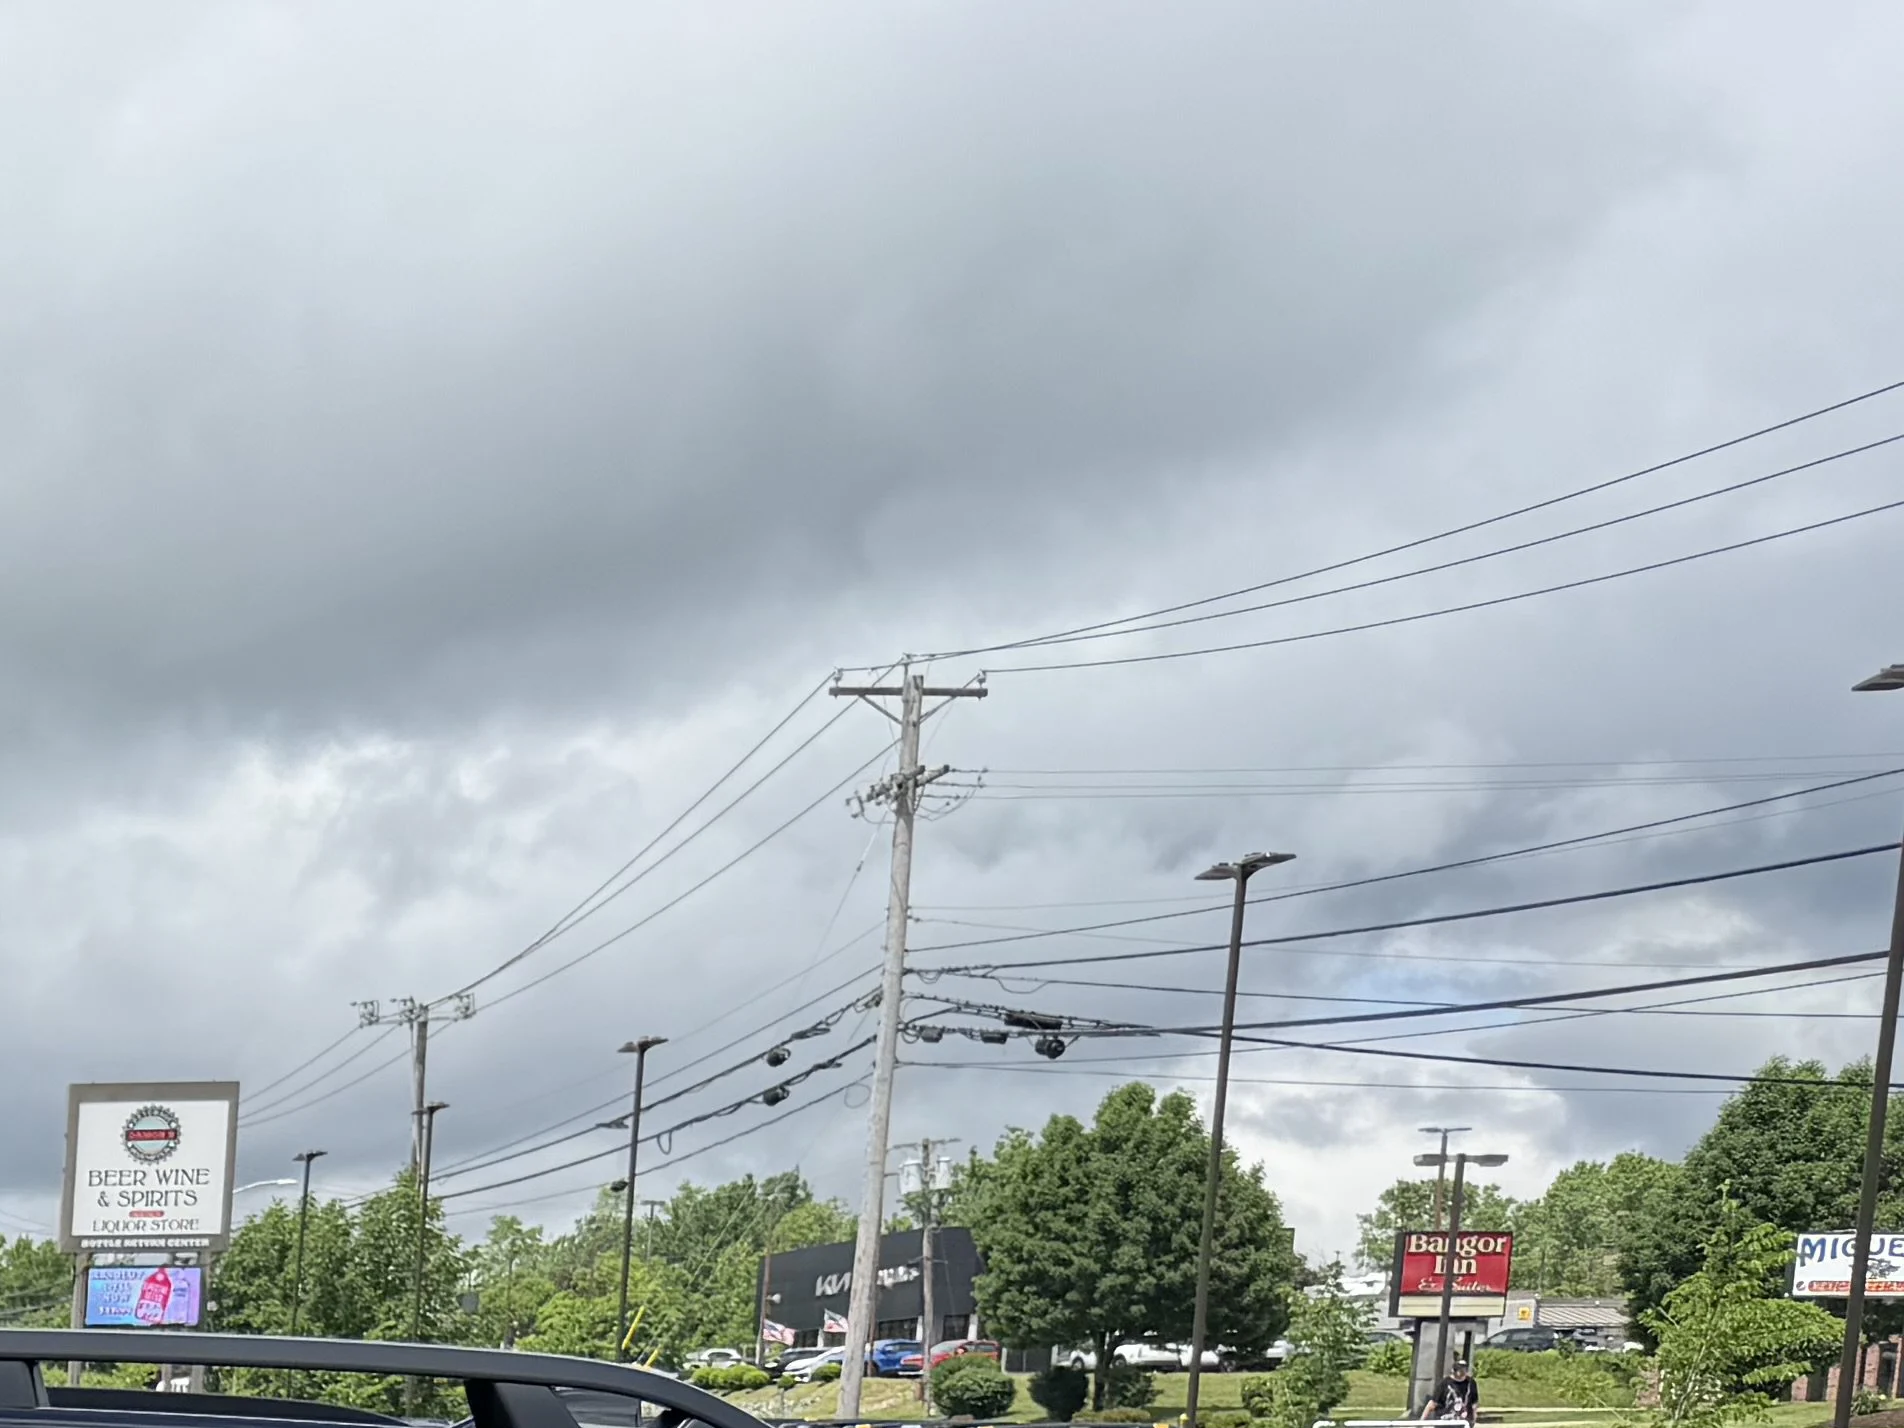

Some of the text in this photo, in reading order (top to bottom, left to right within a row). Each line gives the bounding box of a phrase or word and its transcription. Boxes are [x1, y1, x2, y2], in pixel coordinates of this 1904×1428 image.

[88, 1168, 210, 1187] BEER WINE
[97, 1190, 198, 1208] & SPIRITS
[92, 1218, 200, 1234] LIQUOR STORE
[123, 1238, 166, 1248] RETURN
[166, 1238, 210, 1247] CENTER
[1408, 1234, 1507, 1257] Bangor
[1434, 1255, 1477, 1275] Inn
